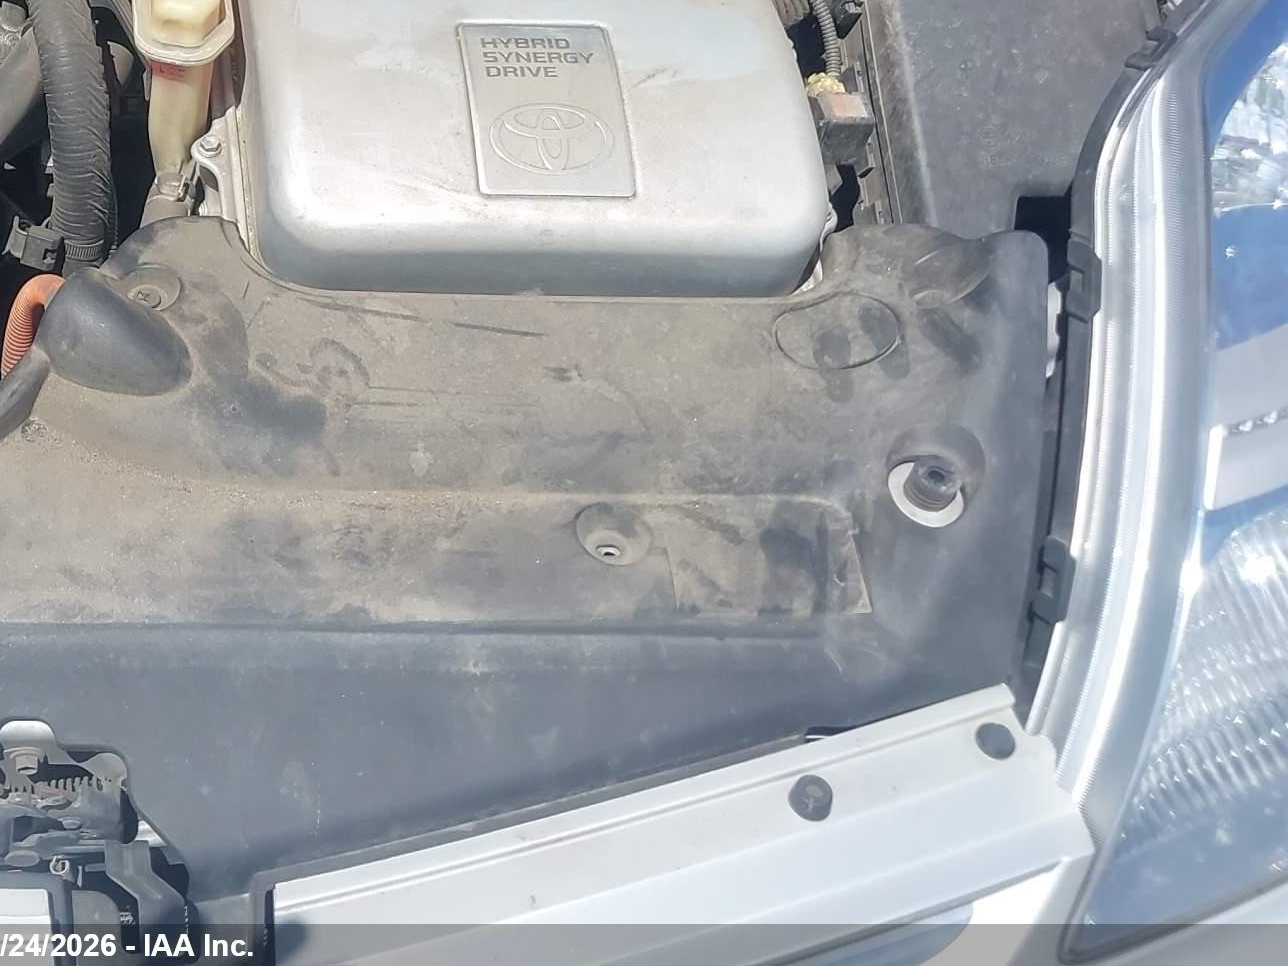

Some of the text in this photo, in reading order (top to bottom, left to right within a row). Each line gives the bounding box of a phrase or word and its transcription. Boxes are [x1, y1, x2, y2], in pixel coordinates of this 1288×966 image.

[481, 37, 570, 50] HYBRID
[483, 52, 594, 64] SYNERGY
[486, 66, 558, 78] DRIVE
